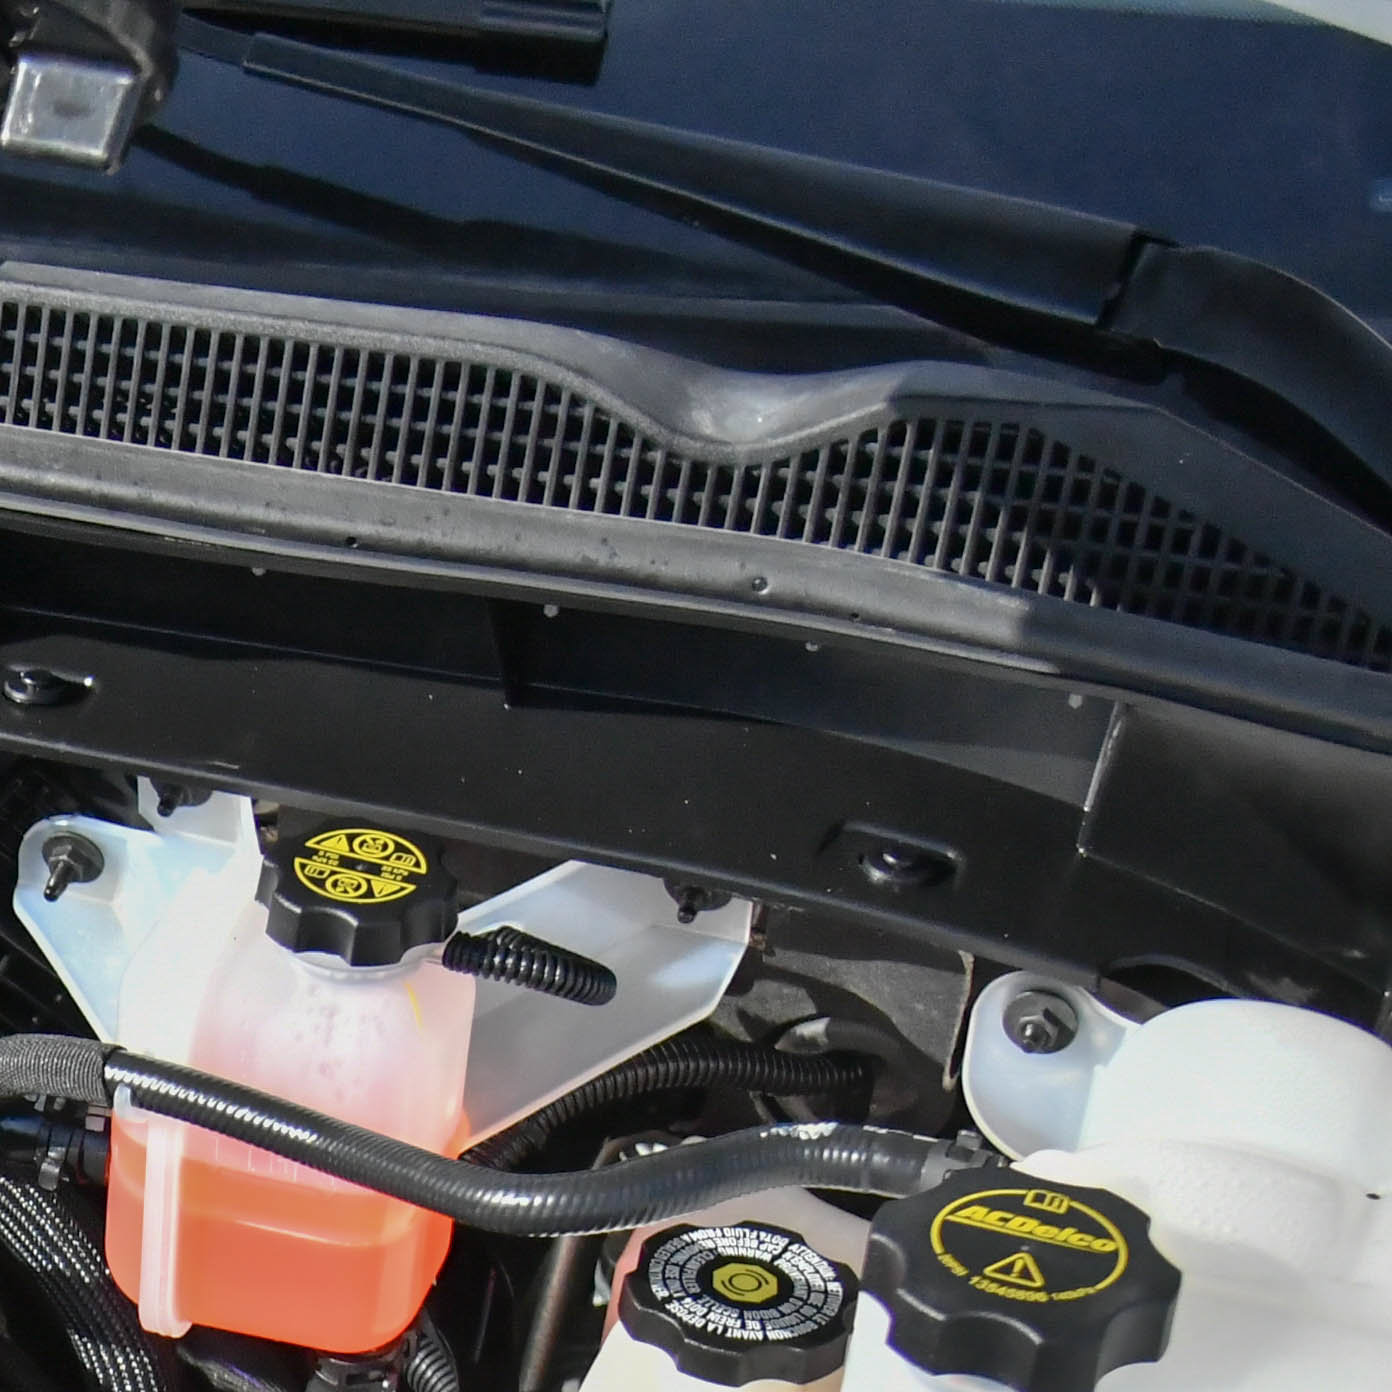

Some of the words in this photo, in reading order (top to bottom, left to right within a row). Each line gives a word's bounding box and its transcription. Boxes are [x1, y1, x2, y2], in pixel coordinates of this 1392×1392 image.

[688, 1228, 722, 1242] FROM
[722, 1227, 758, 1241] FLUID
[954, 1204, 1119, 1252] ACDelco
[715, 1237, 759, 1249] BEFORE
[759, 1242, 783, 1255] CAP
[706, 1311, 743, 1329] FREIN
[743, 1308, 781, 1321] BIDON
[811, 1313, 830, 1326] LE
[707, 1321, 724, 1335] LA
[744, 1320, 762, 1331] DE
[725, 1327, 764, 1341] AVANT
